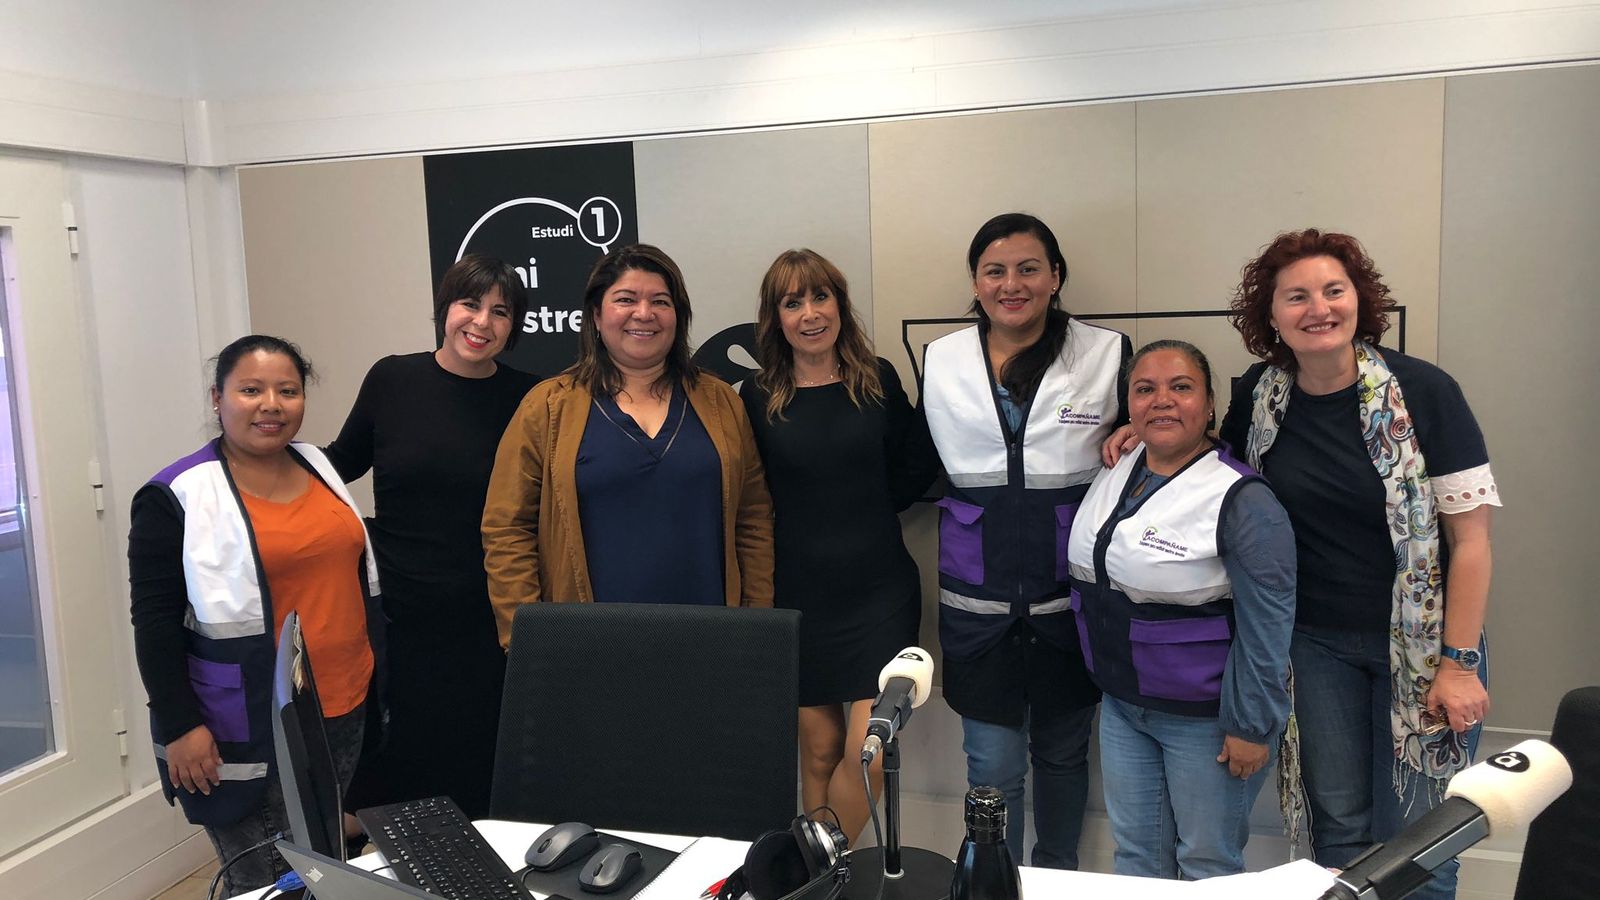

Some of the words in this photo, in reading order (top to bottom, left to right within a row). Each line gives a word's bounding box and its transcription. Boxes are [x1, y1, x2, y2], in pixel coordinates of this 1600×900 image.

[531, 224, 574, 239] Estudi
[591, 207, 605, 237] 1
[522, 306, 583, 334] stre
[1146, 536, 1188, 552] ACOMPAÑAME
